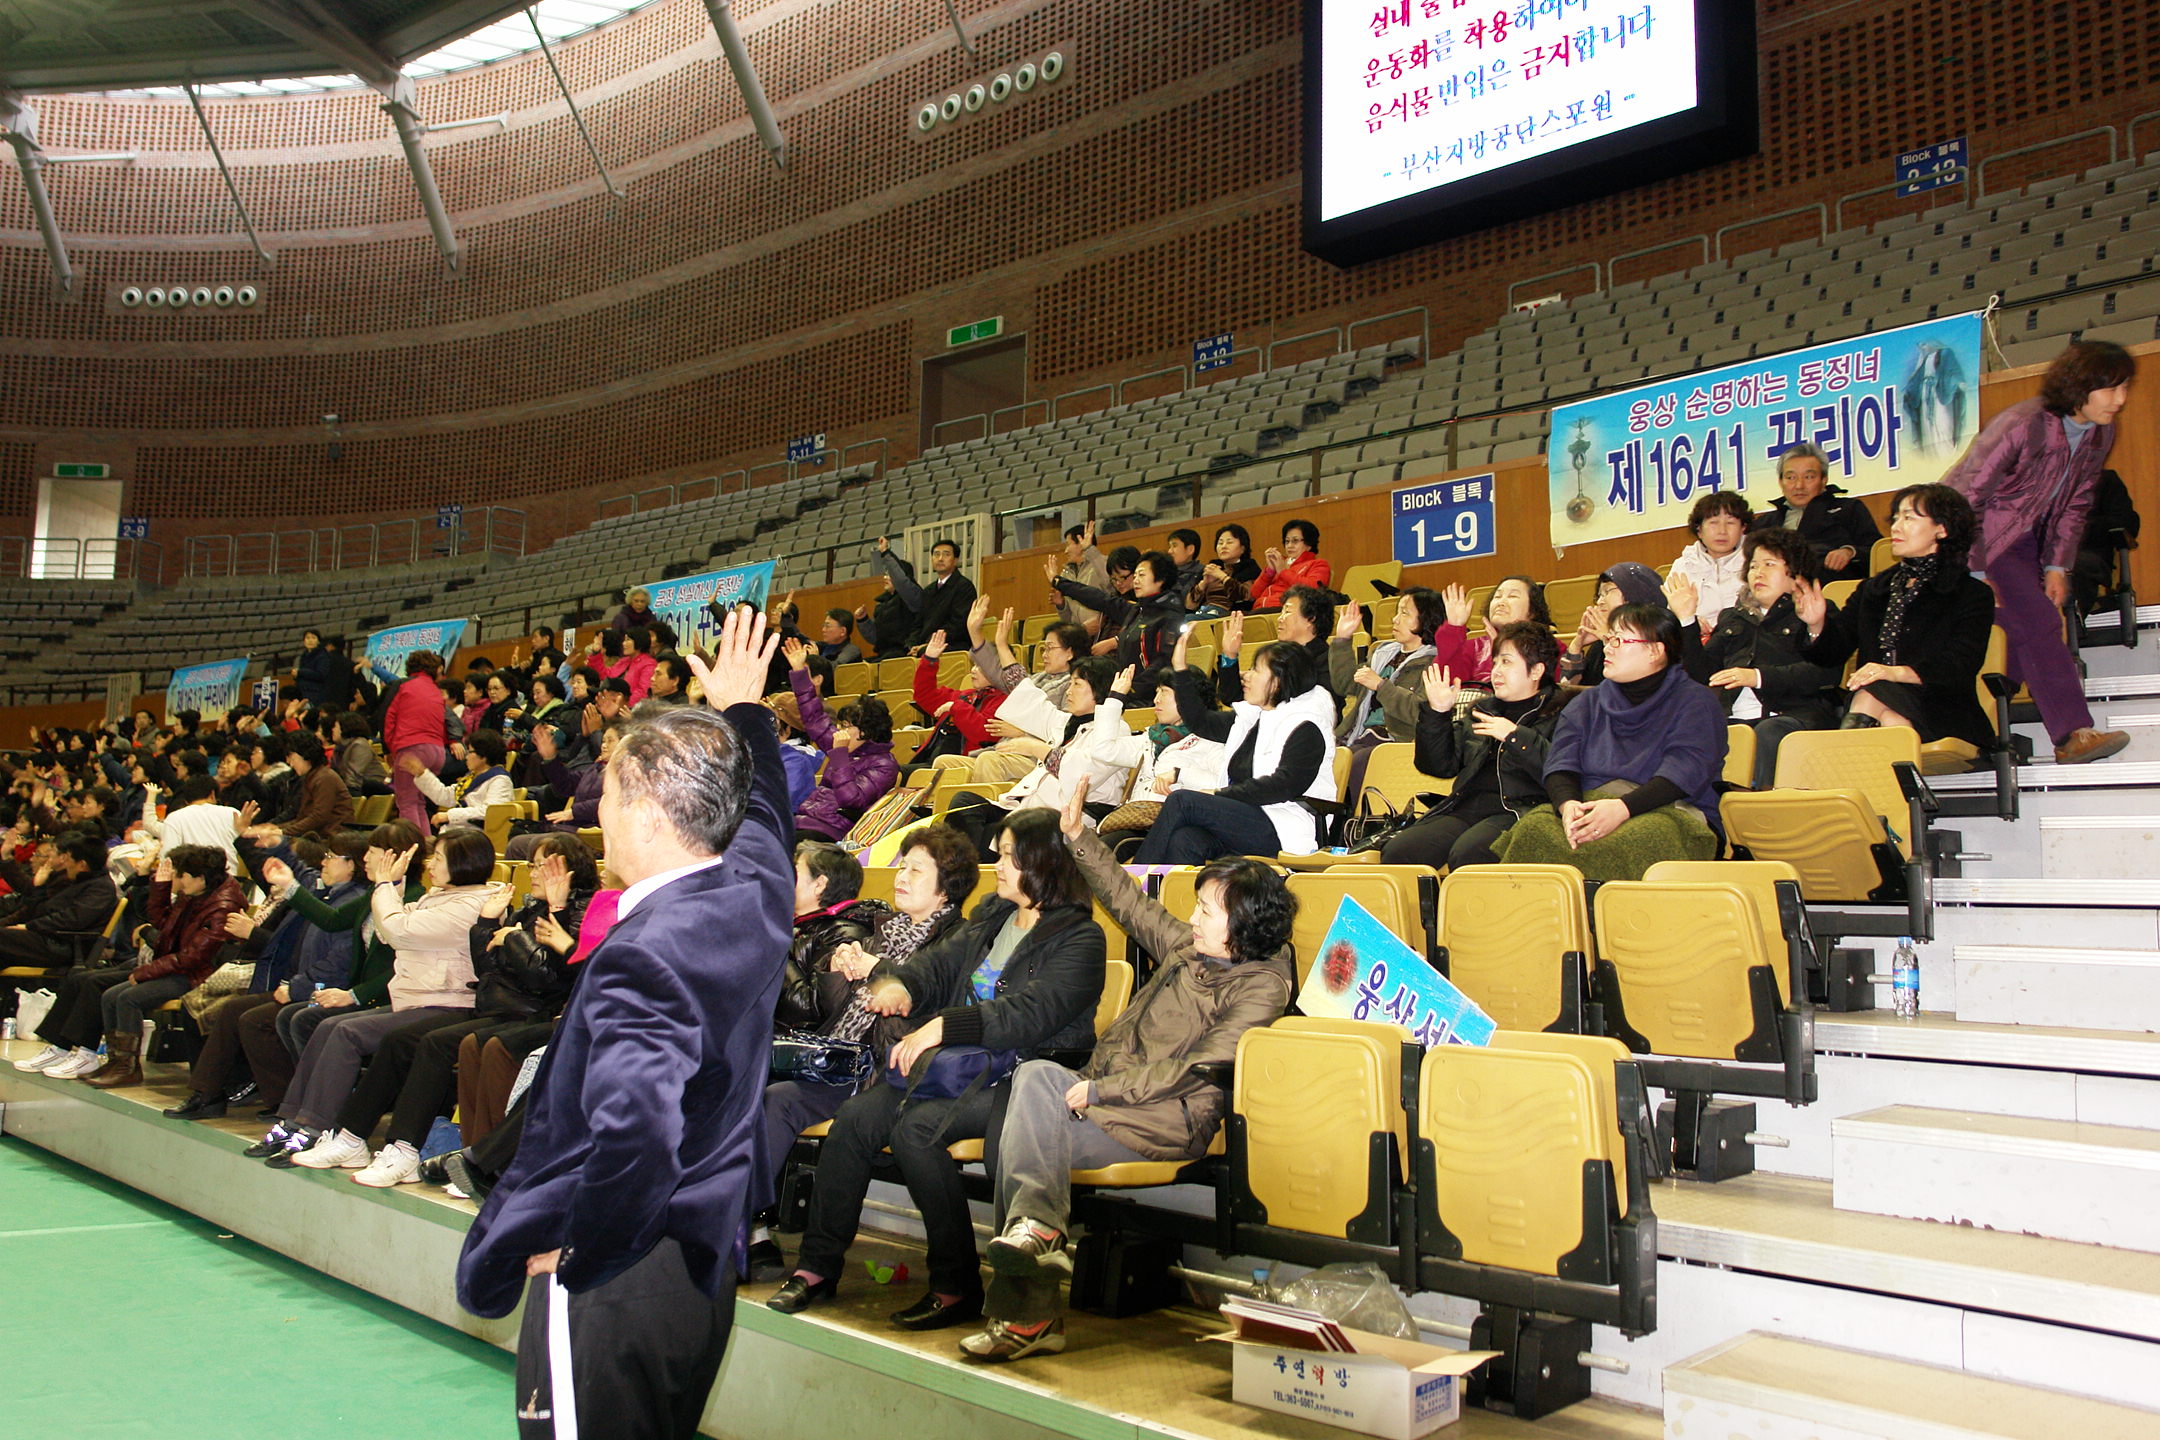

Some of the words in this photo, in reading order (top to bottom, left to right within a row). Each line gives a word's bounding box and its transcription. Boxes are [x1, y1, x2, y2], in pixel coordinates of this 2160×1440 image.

[1369, 0, 1409, 37] 실내
[1520, 5, 1656, 80] 금지합니다
[1363, 30, 1455, 88] 운동화를
[1628, 394, 1677, 433] 웅상
[1685, 374, 1787, 422] 순명하는
[1797, 348, 1880, 398] 동정녀
[1402, 489, 1442, 511] Block
[1452, 481, 1482, 502] 블록
[1607, 424, 1747, 513] 제1641
[1411, 510, 1478, 558] 1-9
